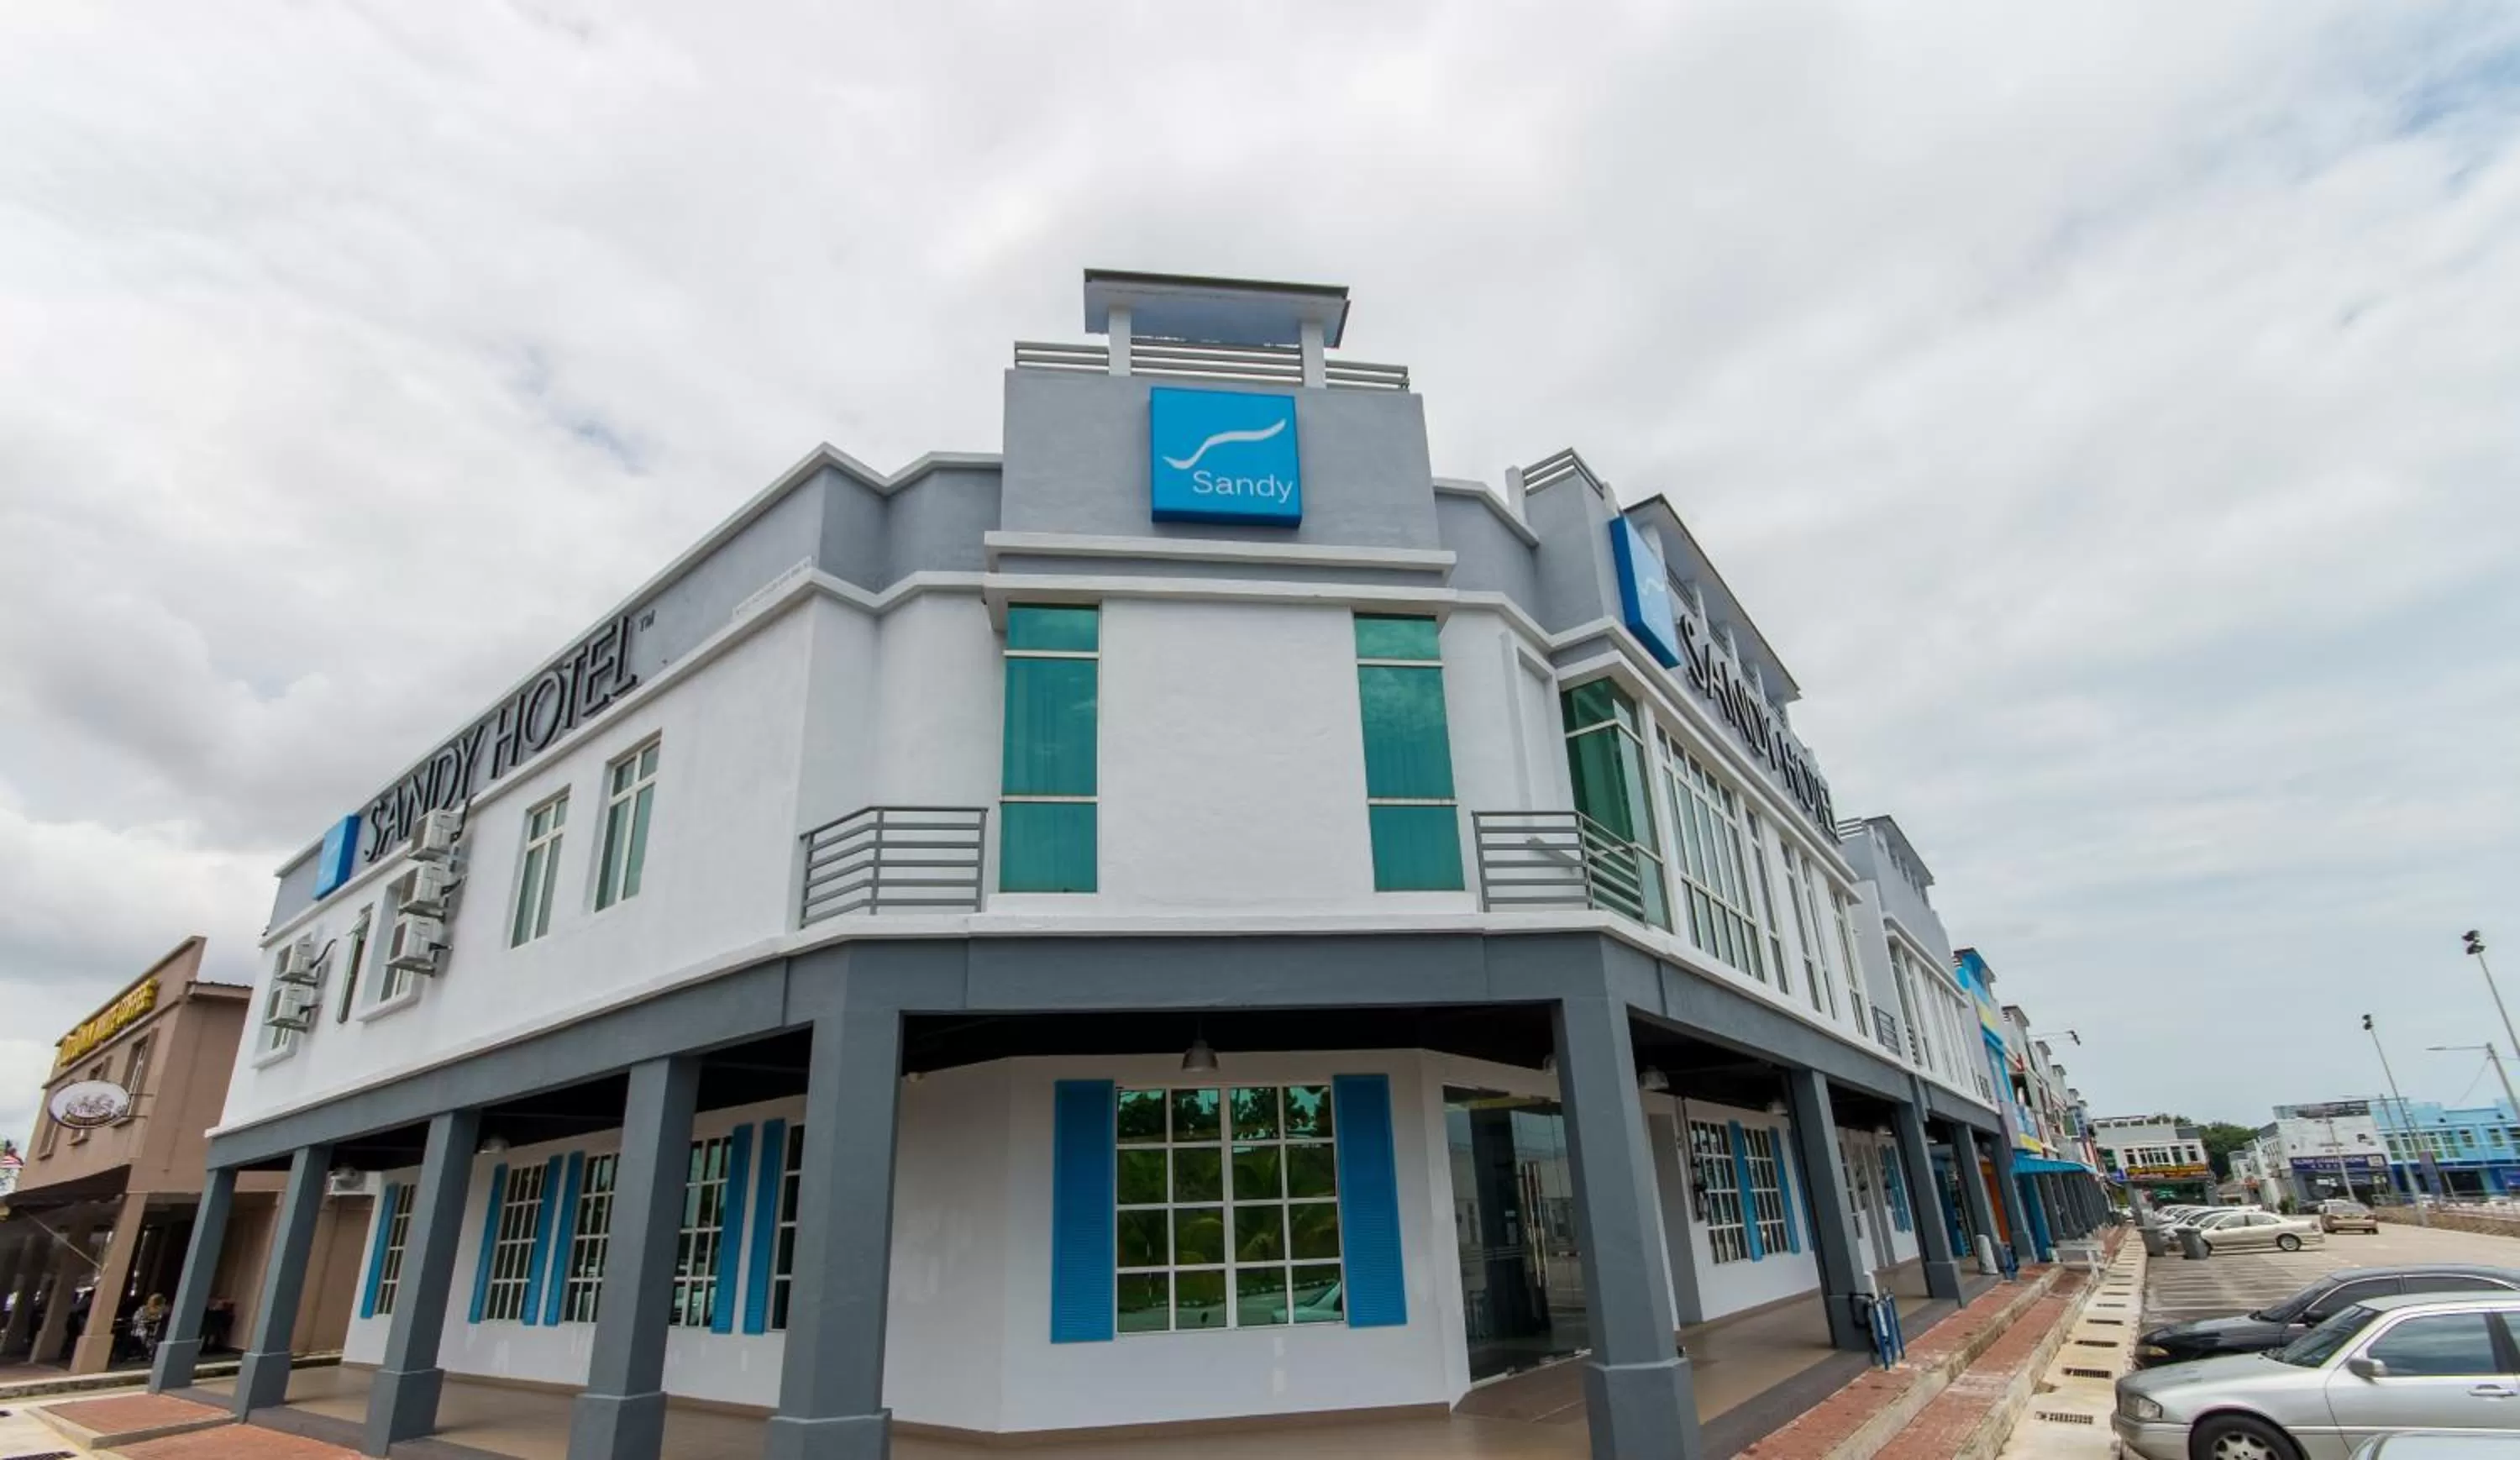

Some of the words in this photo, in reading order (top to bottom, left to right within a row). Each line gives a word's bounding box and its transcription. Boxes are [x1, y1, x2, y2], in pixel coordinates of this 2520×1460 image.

[1193, 470, 1293, 503] Sandy
[364, 726, 485, 862] SANDY
[491, 616, 637, 780] HOTEL
[1680, 614, 1777, 770] SANDY
